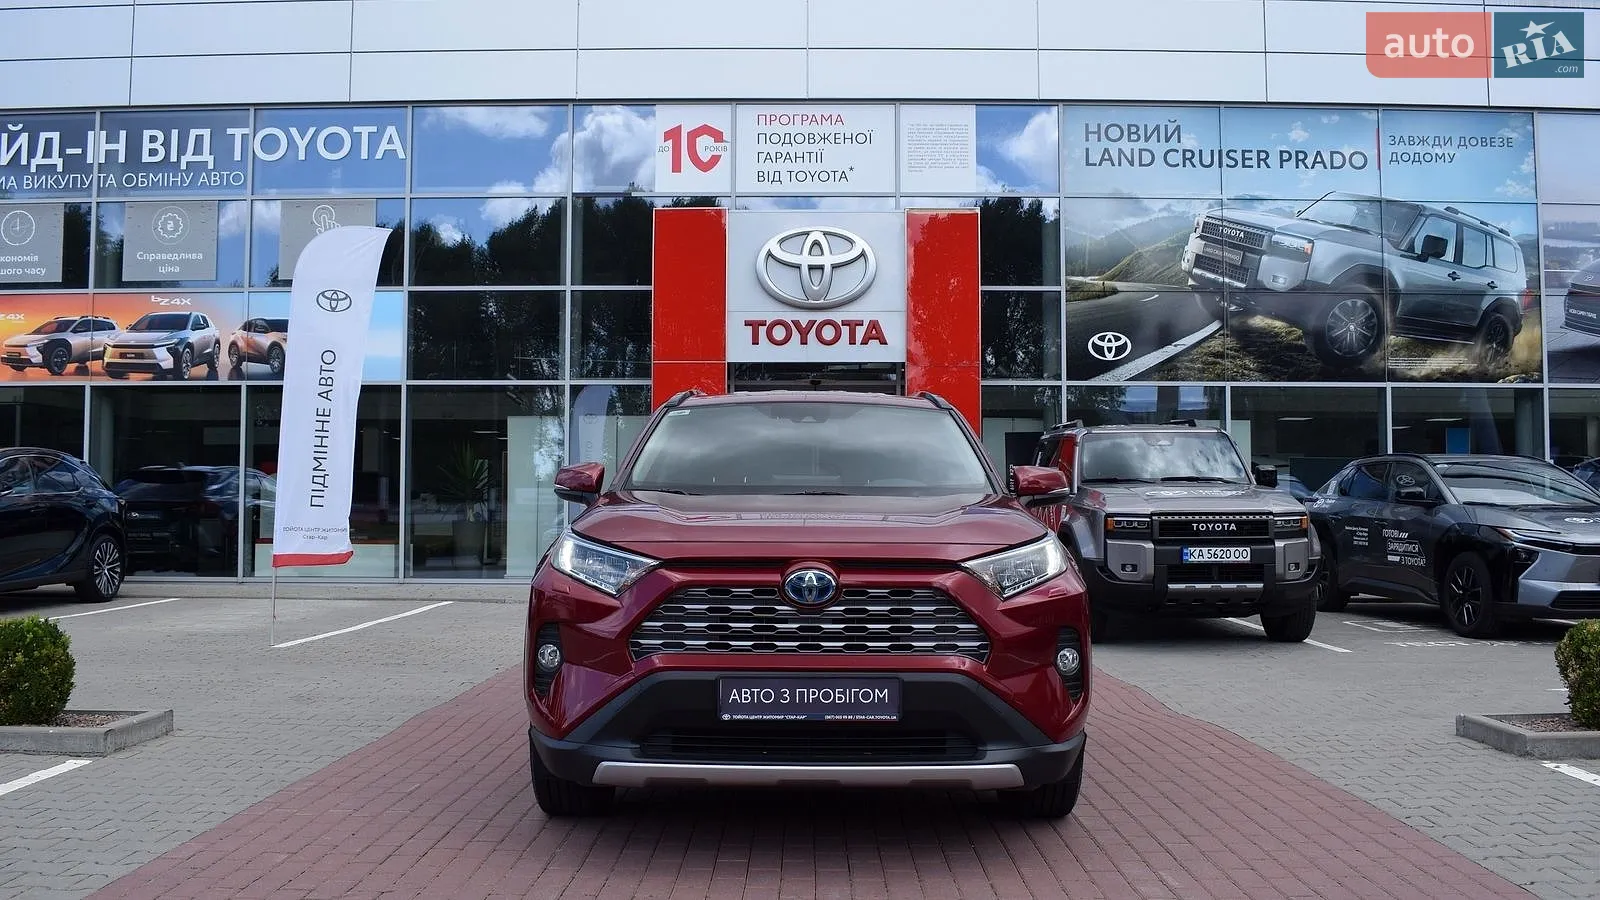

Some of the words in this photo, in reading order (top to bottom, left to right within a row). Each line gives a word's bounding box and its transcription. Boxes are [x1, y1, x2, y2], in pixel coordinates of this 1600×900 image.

[757, 113, 845, 126] ПРОГРАМА
[757, 129, 874, 147] ПОДОВЖЕНОЇ
[1085, 119, 1182, 143] НОВИЙ
[141, 128, 215, 170] ВІД
[226, 125, 407, 162] TOYOTA
[658, 145, 670, 153] ДО
[704, 145, 728, 153] РОКІВ
[1389, 135, 1453, 148] ЗАВЖДИ
[1457, 136, 1514, 150] ДОВЕЗЕ
[757, 148, 825, 164] ГАРАНТІЇ
[1085, 148, 1156, 168] LAND
[1163, 148, 1271, 169] CRUISER
[1279, 150, 1368, 170] PRADO
[1389, 151, 1456, 165] ДОДОМУ
[23, 174, 93, 190] ВИКУПУ
[98, 173, 117, 188] ТА
[122, 172, 194, 187] ОБМІНУ
[198, 171, 244, 187] АВТО
[757, 170, 783, 184] ВІД
[1219, 226, 1244, 239] TOYOTA
[136, 250, 203, 263] Справедлива
[24, 268, 46, 276] часу
[158, 264, 181, 274] ціна
[744, 318, 888, 346] TOYOTA
[317, 349, 337, 402] АВТО
[310, 407, 331, 508] ПІДМІННЕ
[1191, 523, 1237, 531] TOYOTA
[1189, 549, 1204, 559] KA
[1207, 549, 1232, 559] 5620
[728, 688, 775, 703] АВТО
[780, 688, 790, 703] З
[796, 688, 888, 703] ПРОБІГОМ
